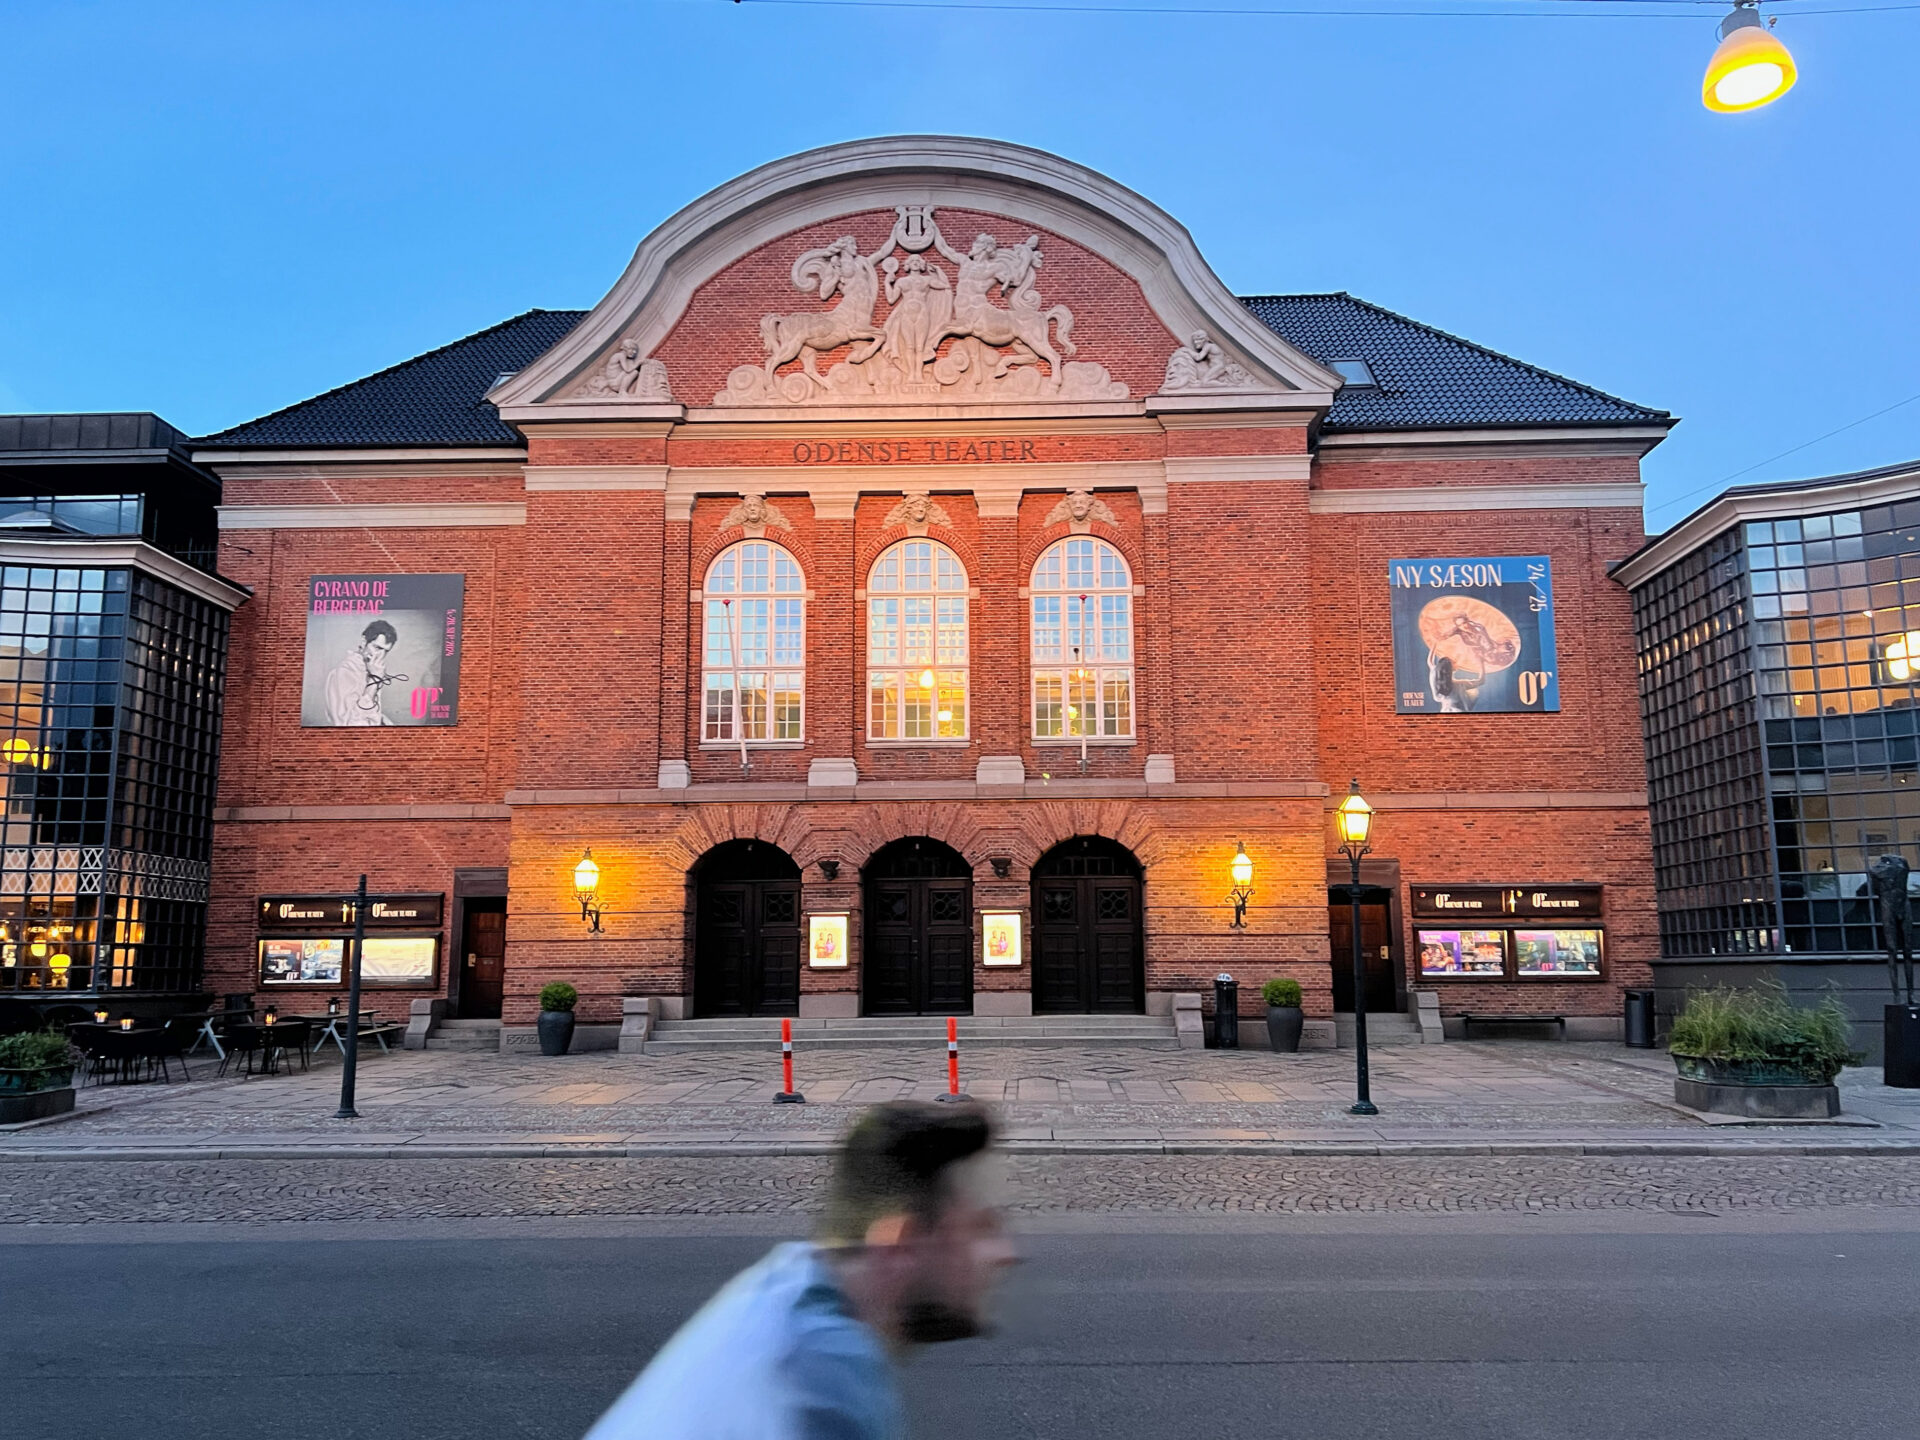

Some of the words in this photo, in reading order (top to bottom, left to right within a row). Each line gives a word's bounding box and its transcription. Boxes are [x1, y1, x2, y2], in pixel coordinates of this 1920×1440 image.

[793, 441, 911, 463] ODENSE
[926, 439, 1038, 462] TEATER
[1396, 565, 1423, 589] NY
[1430, 563, 1503, 588] SÆSON
[1527, 563, 1548, 612] 24/25
[314, 581, 370, 597] CYRANO
[372, 581, 391, 597] DE
[313, 599, 384, 616] BERGERAC
